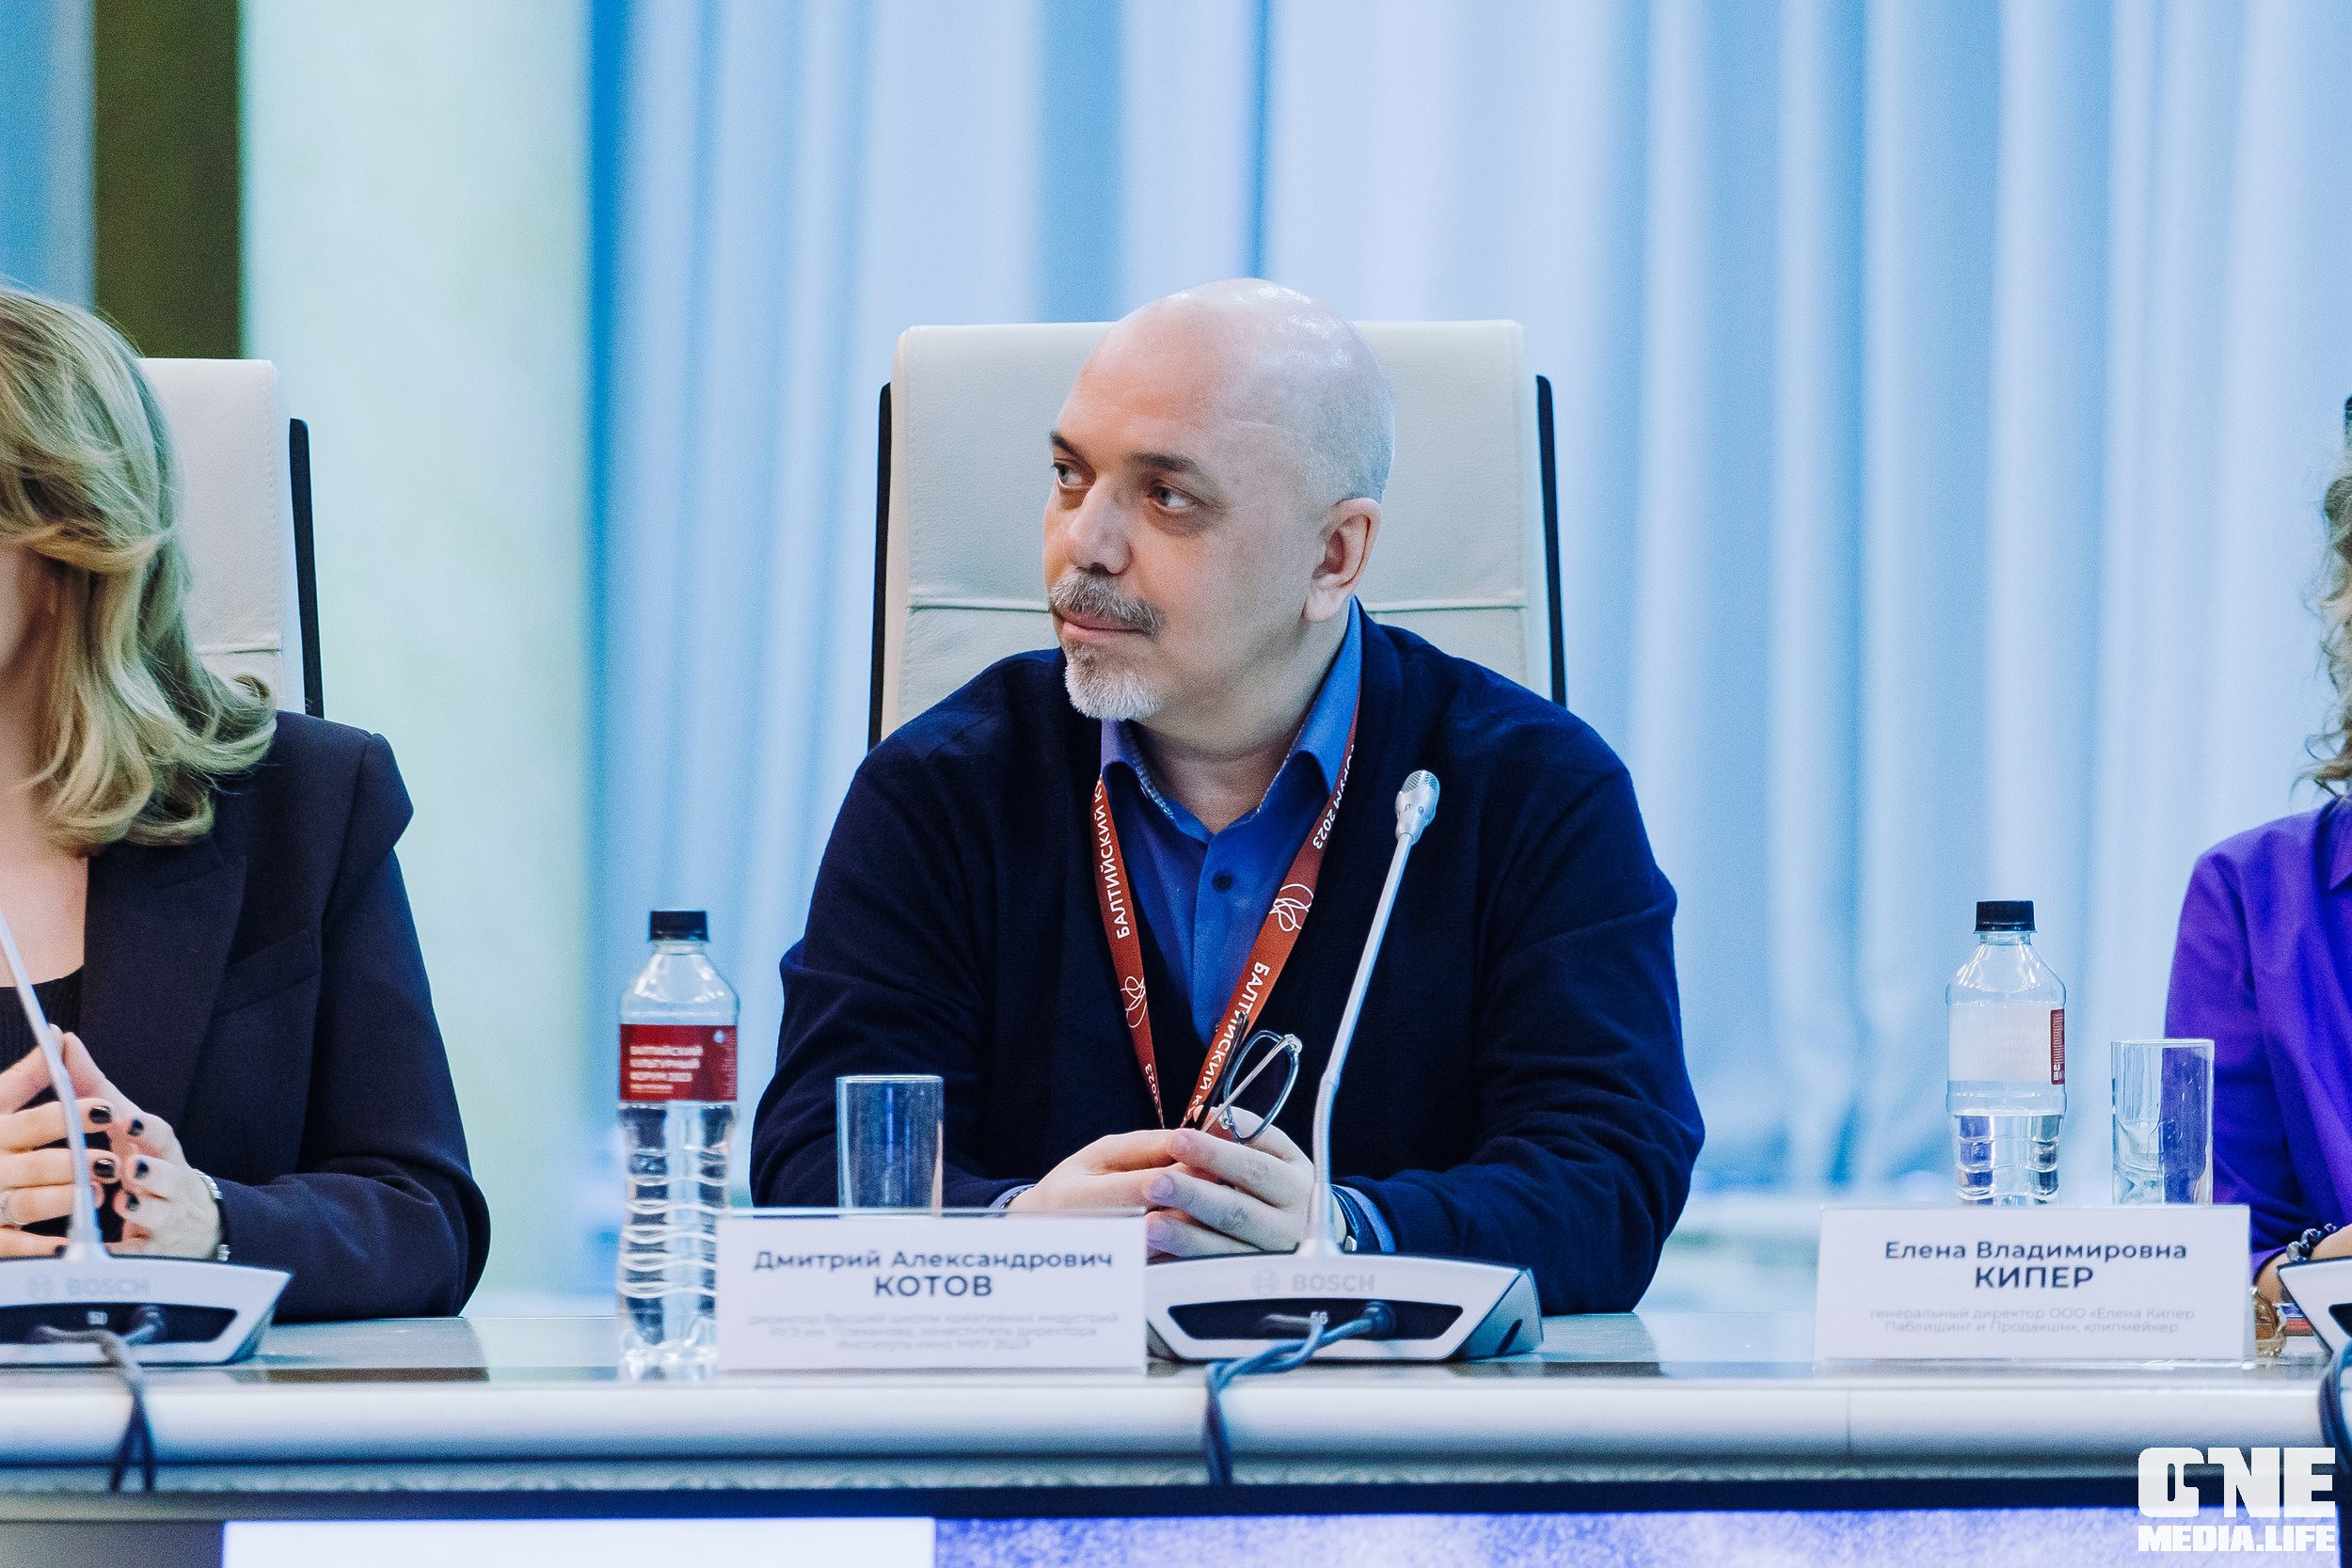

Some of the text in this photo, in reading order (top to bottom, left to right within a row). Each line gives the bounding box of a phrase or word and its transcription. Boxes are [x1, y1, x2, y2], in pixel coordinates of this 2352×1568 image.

[1313, 808, 1337, 849] 2023
[1094, 805, 1131, 940] БАЛТИЙСКИЙ
[753, 1250, 1114, 1273] Дмитрий Александрович
[1884, 1240, 2188, 1263] Елена Владимировна
[874, 1275, 993, 1297] КОТОВ
[1292, 1275, 1375, 1292] BOSCH
[1975, 1266, 2094, 1290] КИПЕР
[1870, 1307, 2196, 1322] генеральный директор ООО «Елена Кипер
[1884, 1321, 1972, 1333] Паблишинг
[1976, 1323, 1986, 1332] и
[2084, 1321, 2180, 1335] клипмейкер
